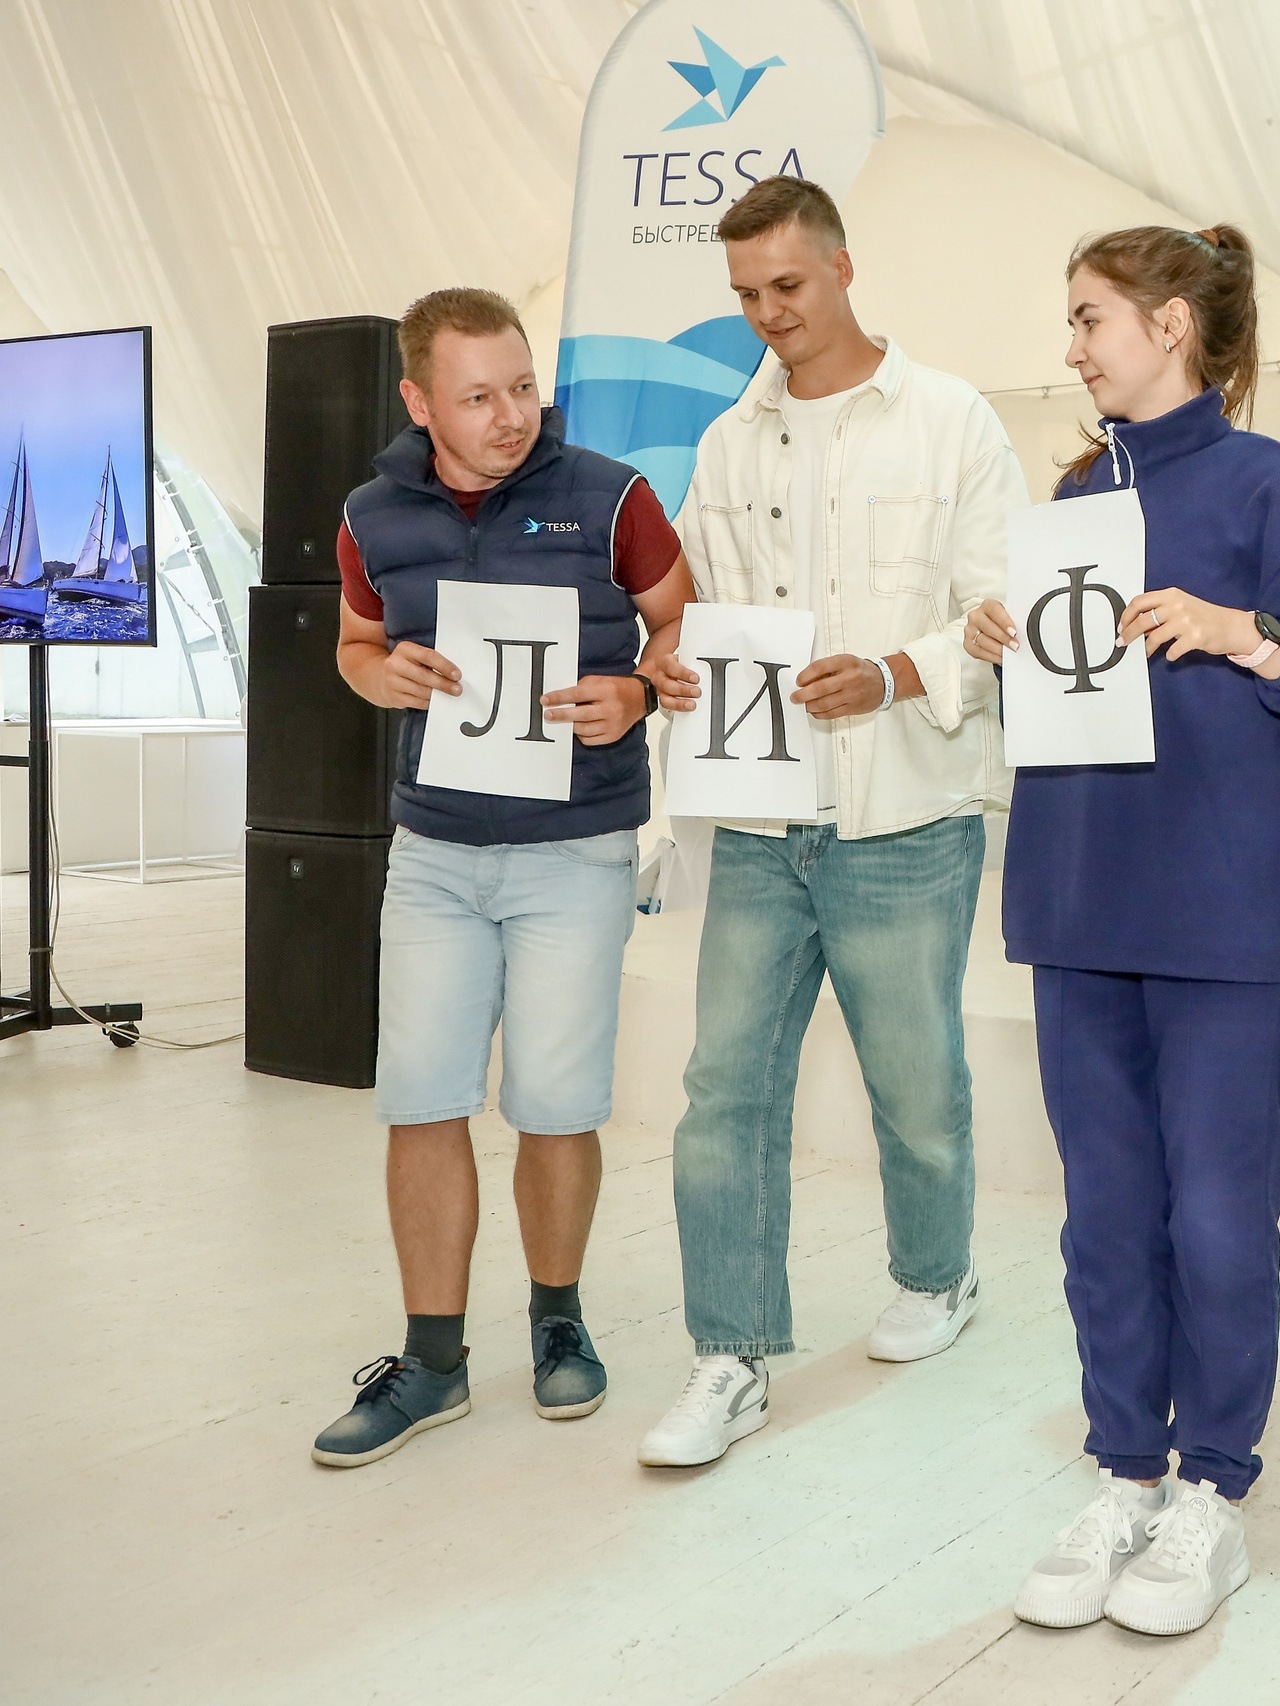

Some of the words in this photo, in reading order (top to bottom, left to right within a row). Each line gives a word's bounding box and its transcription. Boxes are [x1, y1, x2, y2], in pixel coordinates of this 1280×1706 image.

[546, 522, 581, 532] TESSA
[1026, 564, 1130, 695] Ф
[459, 637, 559, 743] Л
[693, 656, 801, 762] И
